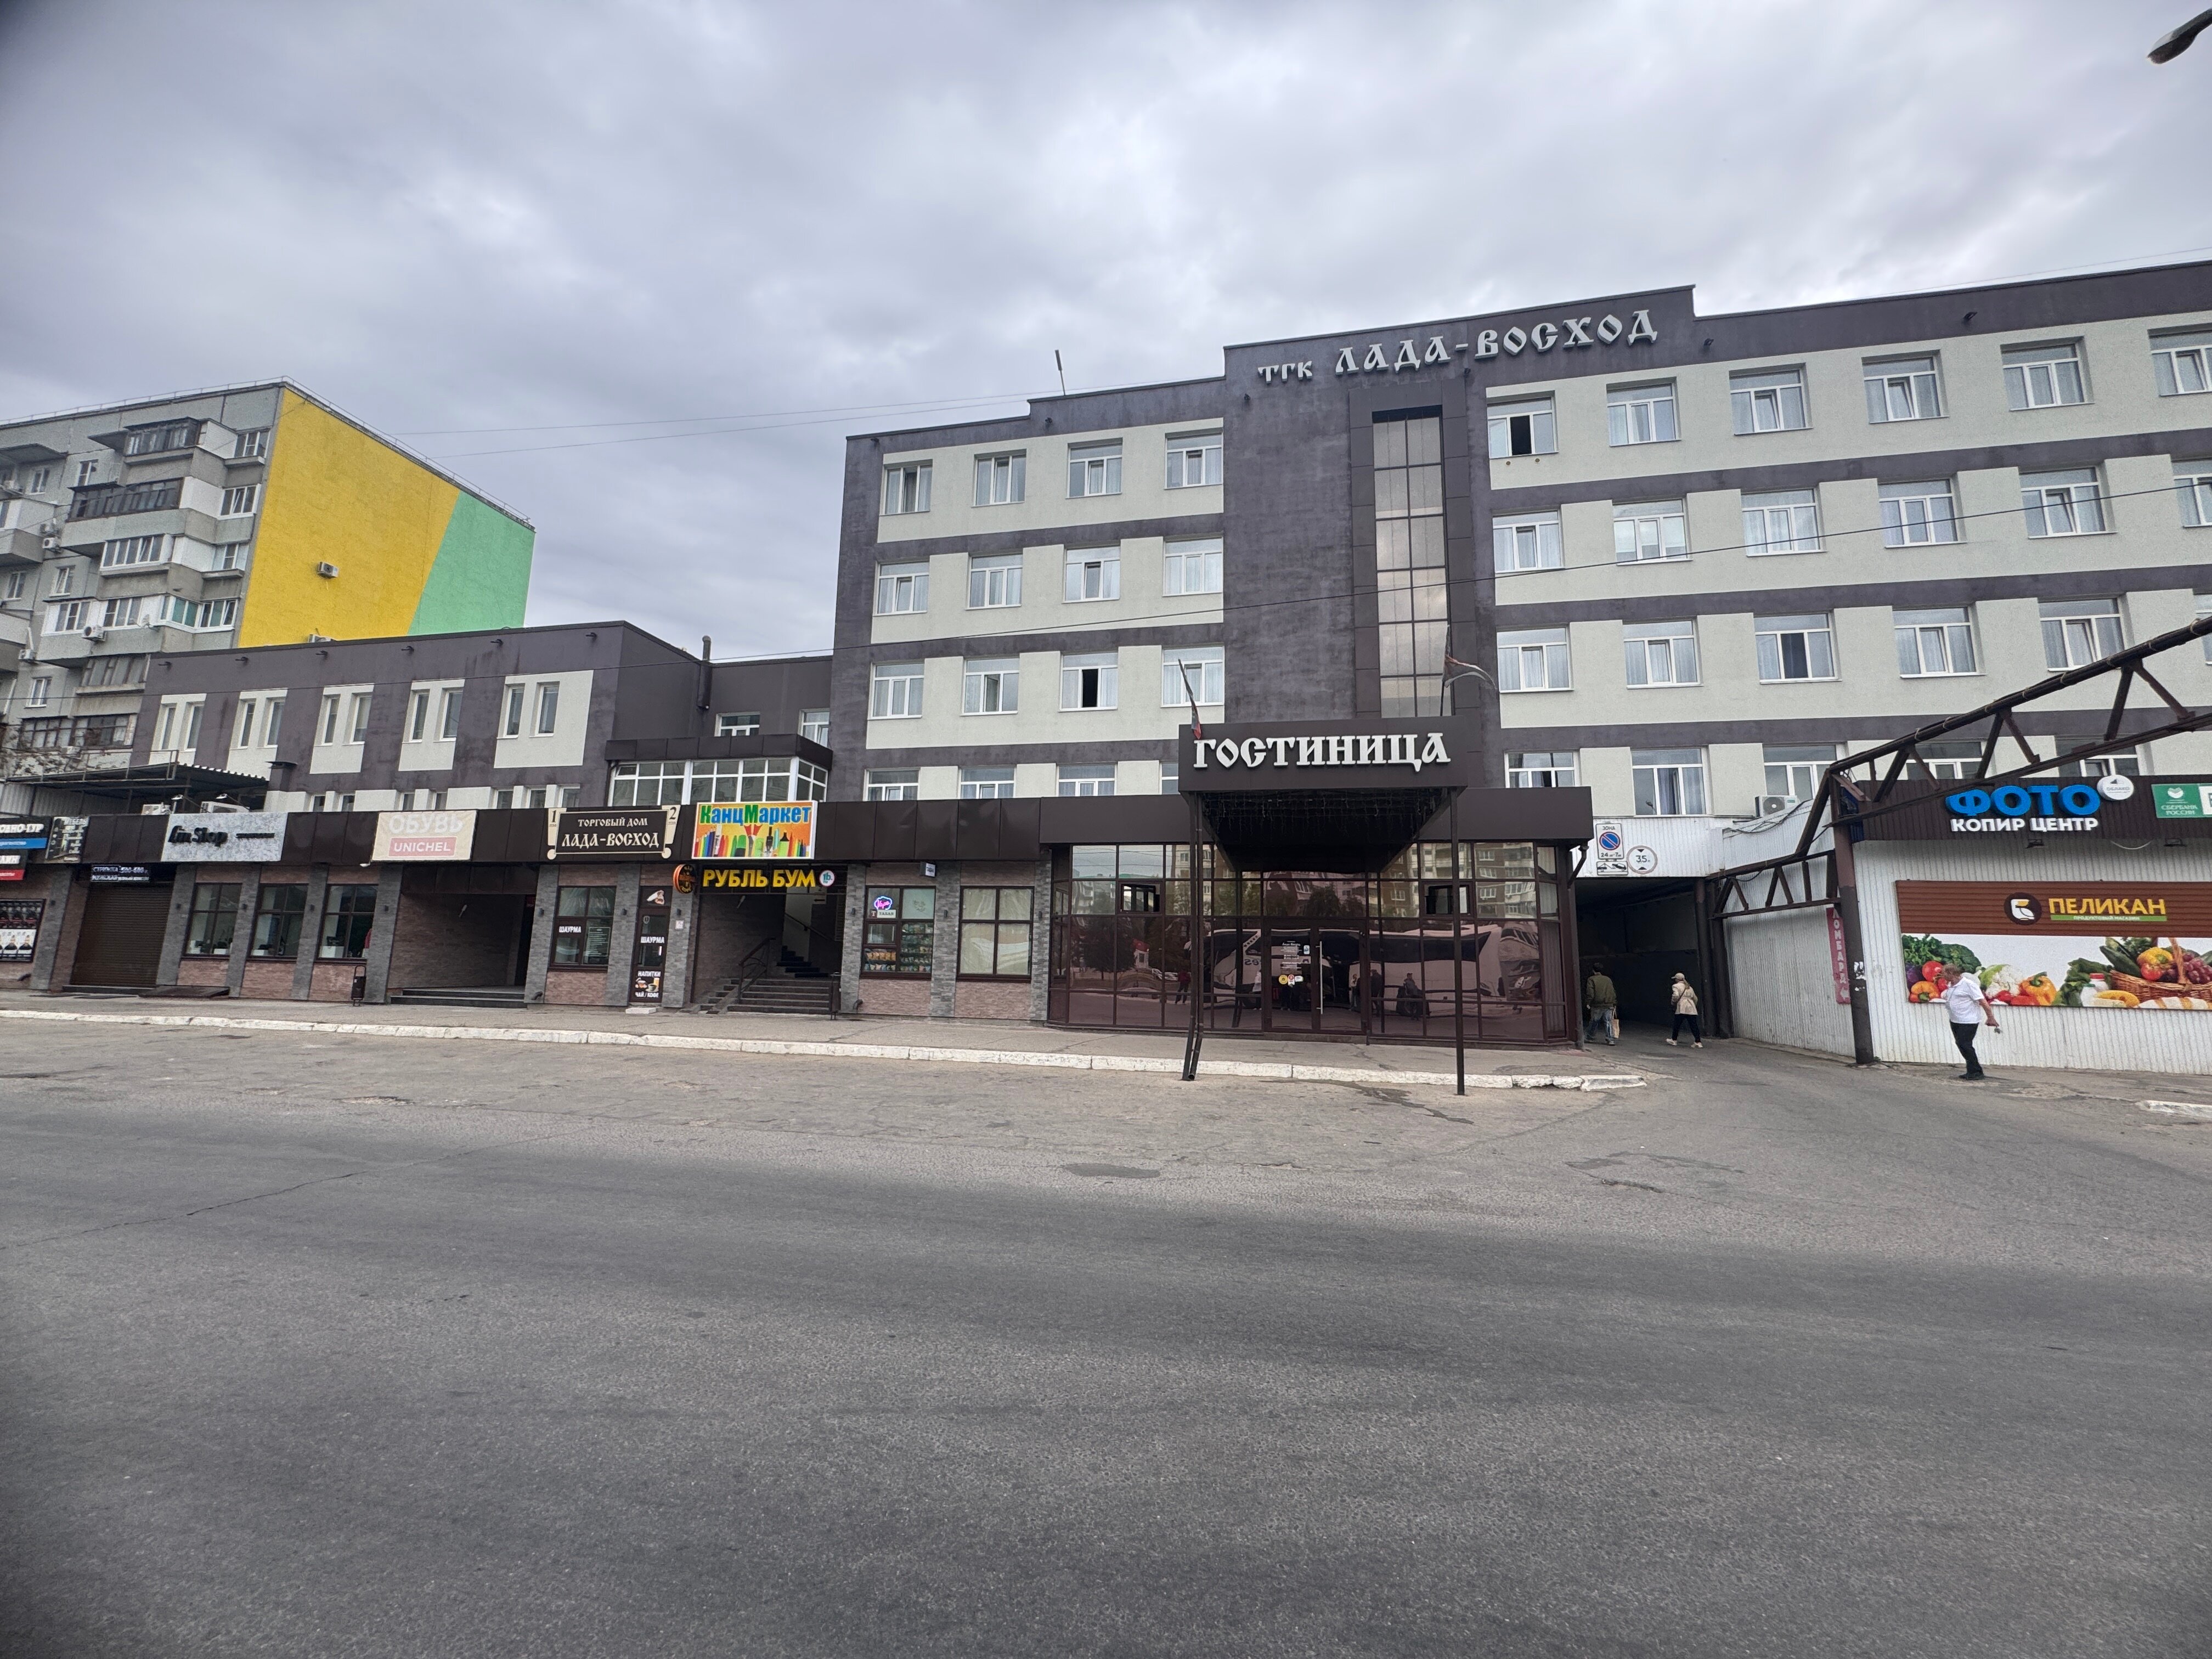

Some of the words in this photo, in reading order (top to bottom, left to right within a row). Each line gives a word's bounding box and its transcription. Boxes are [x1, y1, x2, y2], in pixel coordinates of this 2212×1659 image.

[1334, 309, 1658, 375] ЛАДА-ВОСХОД
[1193, 732, 1452, 772] ГОСТИНИЦА
[1945, 784, 2101, 816] ФОТО
[578, 817, 625, 827] ТОРГОВЫЙ
[627, 818, 648, 827] ДОМ
[669, 806, 678, 820] 2
[699, 804, 812, 826] КанцМаркет
[389, 812, 464, 834] ОБУВЬ
[1950, 818, 2025, 832] КОПИР
[2030, 817, 2099, 832] ЦЕНТР
[394, 842, 451, 852] UNICHEL
[561, 832, 659, 849] ЛАДА-ВОСХОД
[702, 869, 769, 887] РУБЛЬ
[772, 869, 816, 887] БУМ
[2048, 898, 2166, 915] ПЕЛИКАН
[1832, 908, 1847, 984] ЛОМБАРД
